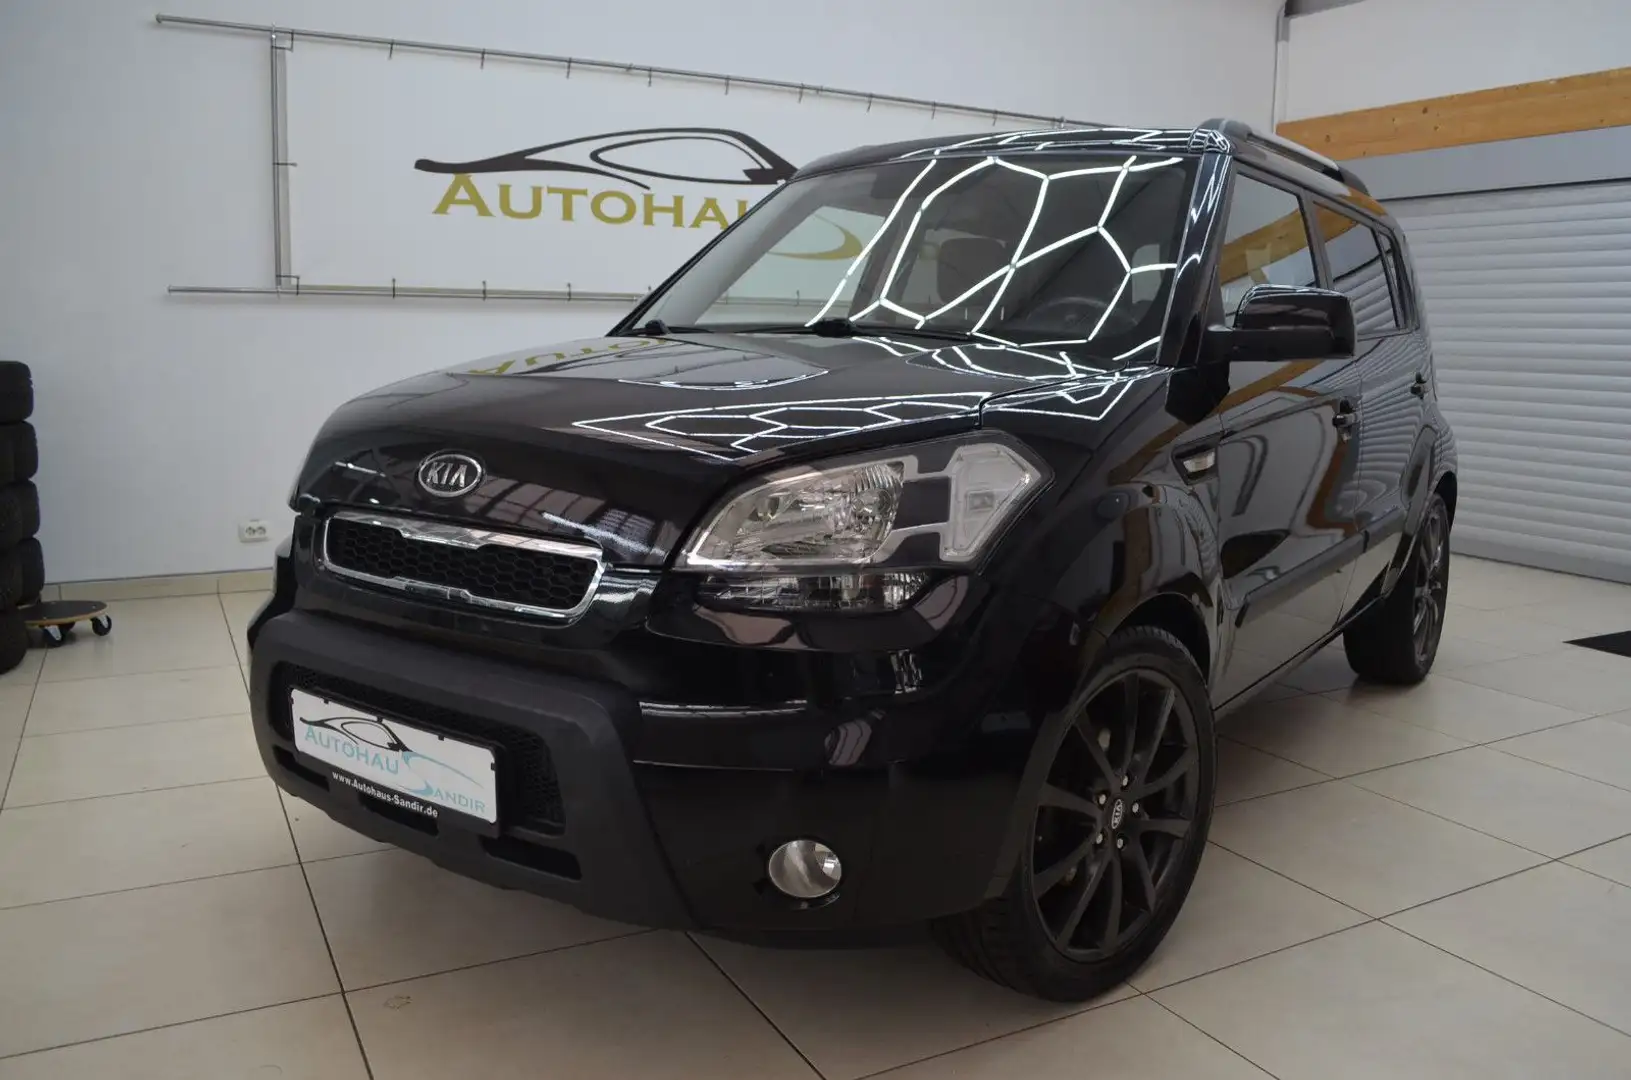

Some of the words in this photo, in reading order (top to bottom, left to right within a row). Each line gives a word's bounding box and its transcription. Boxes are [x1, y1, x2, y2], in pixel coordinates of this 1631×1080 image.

[433, 173, 748, 231] AUTOHA
[426, 461, 467, 488] KIA
[332, 771, 438, 818] www.Autohaus-Sandir.de
